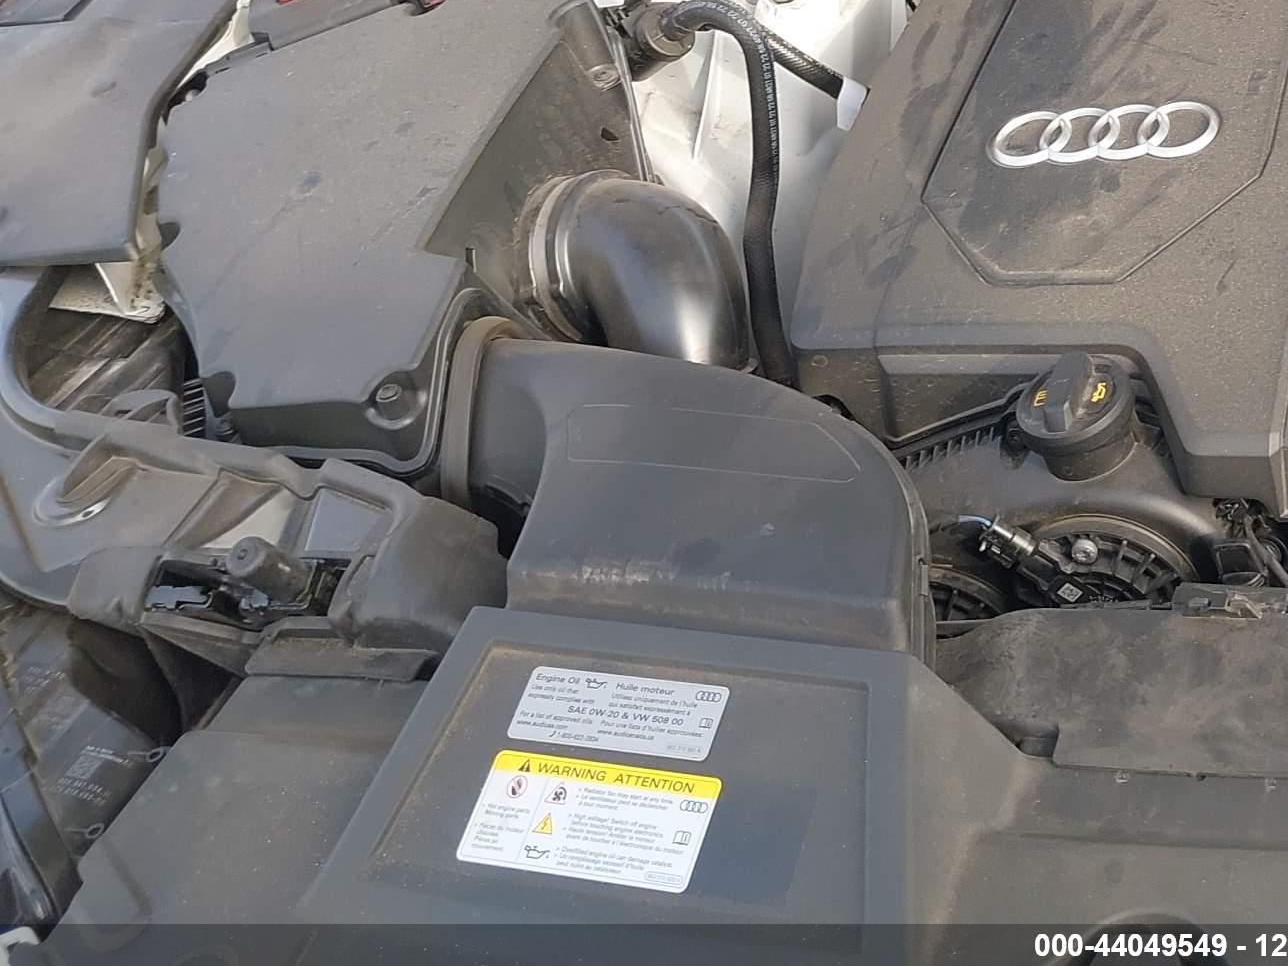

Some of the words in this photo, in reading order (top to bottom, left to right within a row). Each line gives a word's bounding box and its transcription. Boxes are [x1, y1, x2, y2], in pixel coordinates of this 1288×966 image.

[535, 672, 566, 684] Engine
[566, 675, 581, 685] Oil
[614, 682, 639, 691] Huile
[640, 684, 675, 695] moteur
[566, 705, 588, 714] SAE
[620, 711, 630, 719] &
[631, 713, 649, 722] VW
[650, 715, 670, 724] 508
[670, 717, 684, 726] 00
[535, 761, 608, 782] WARNING
[612, 772, 696, 794] ATTENTION
